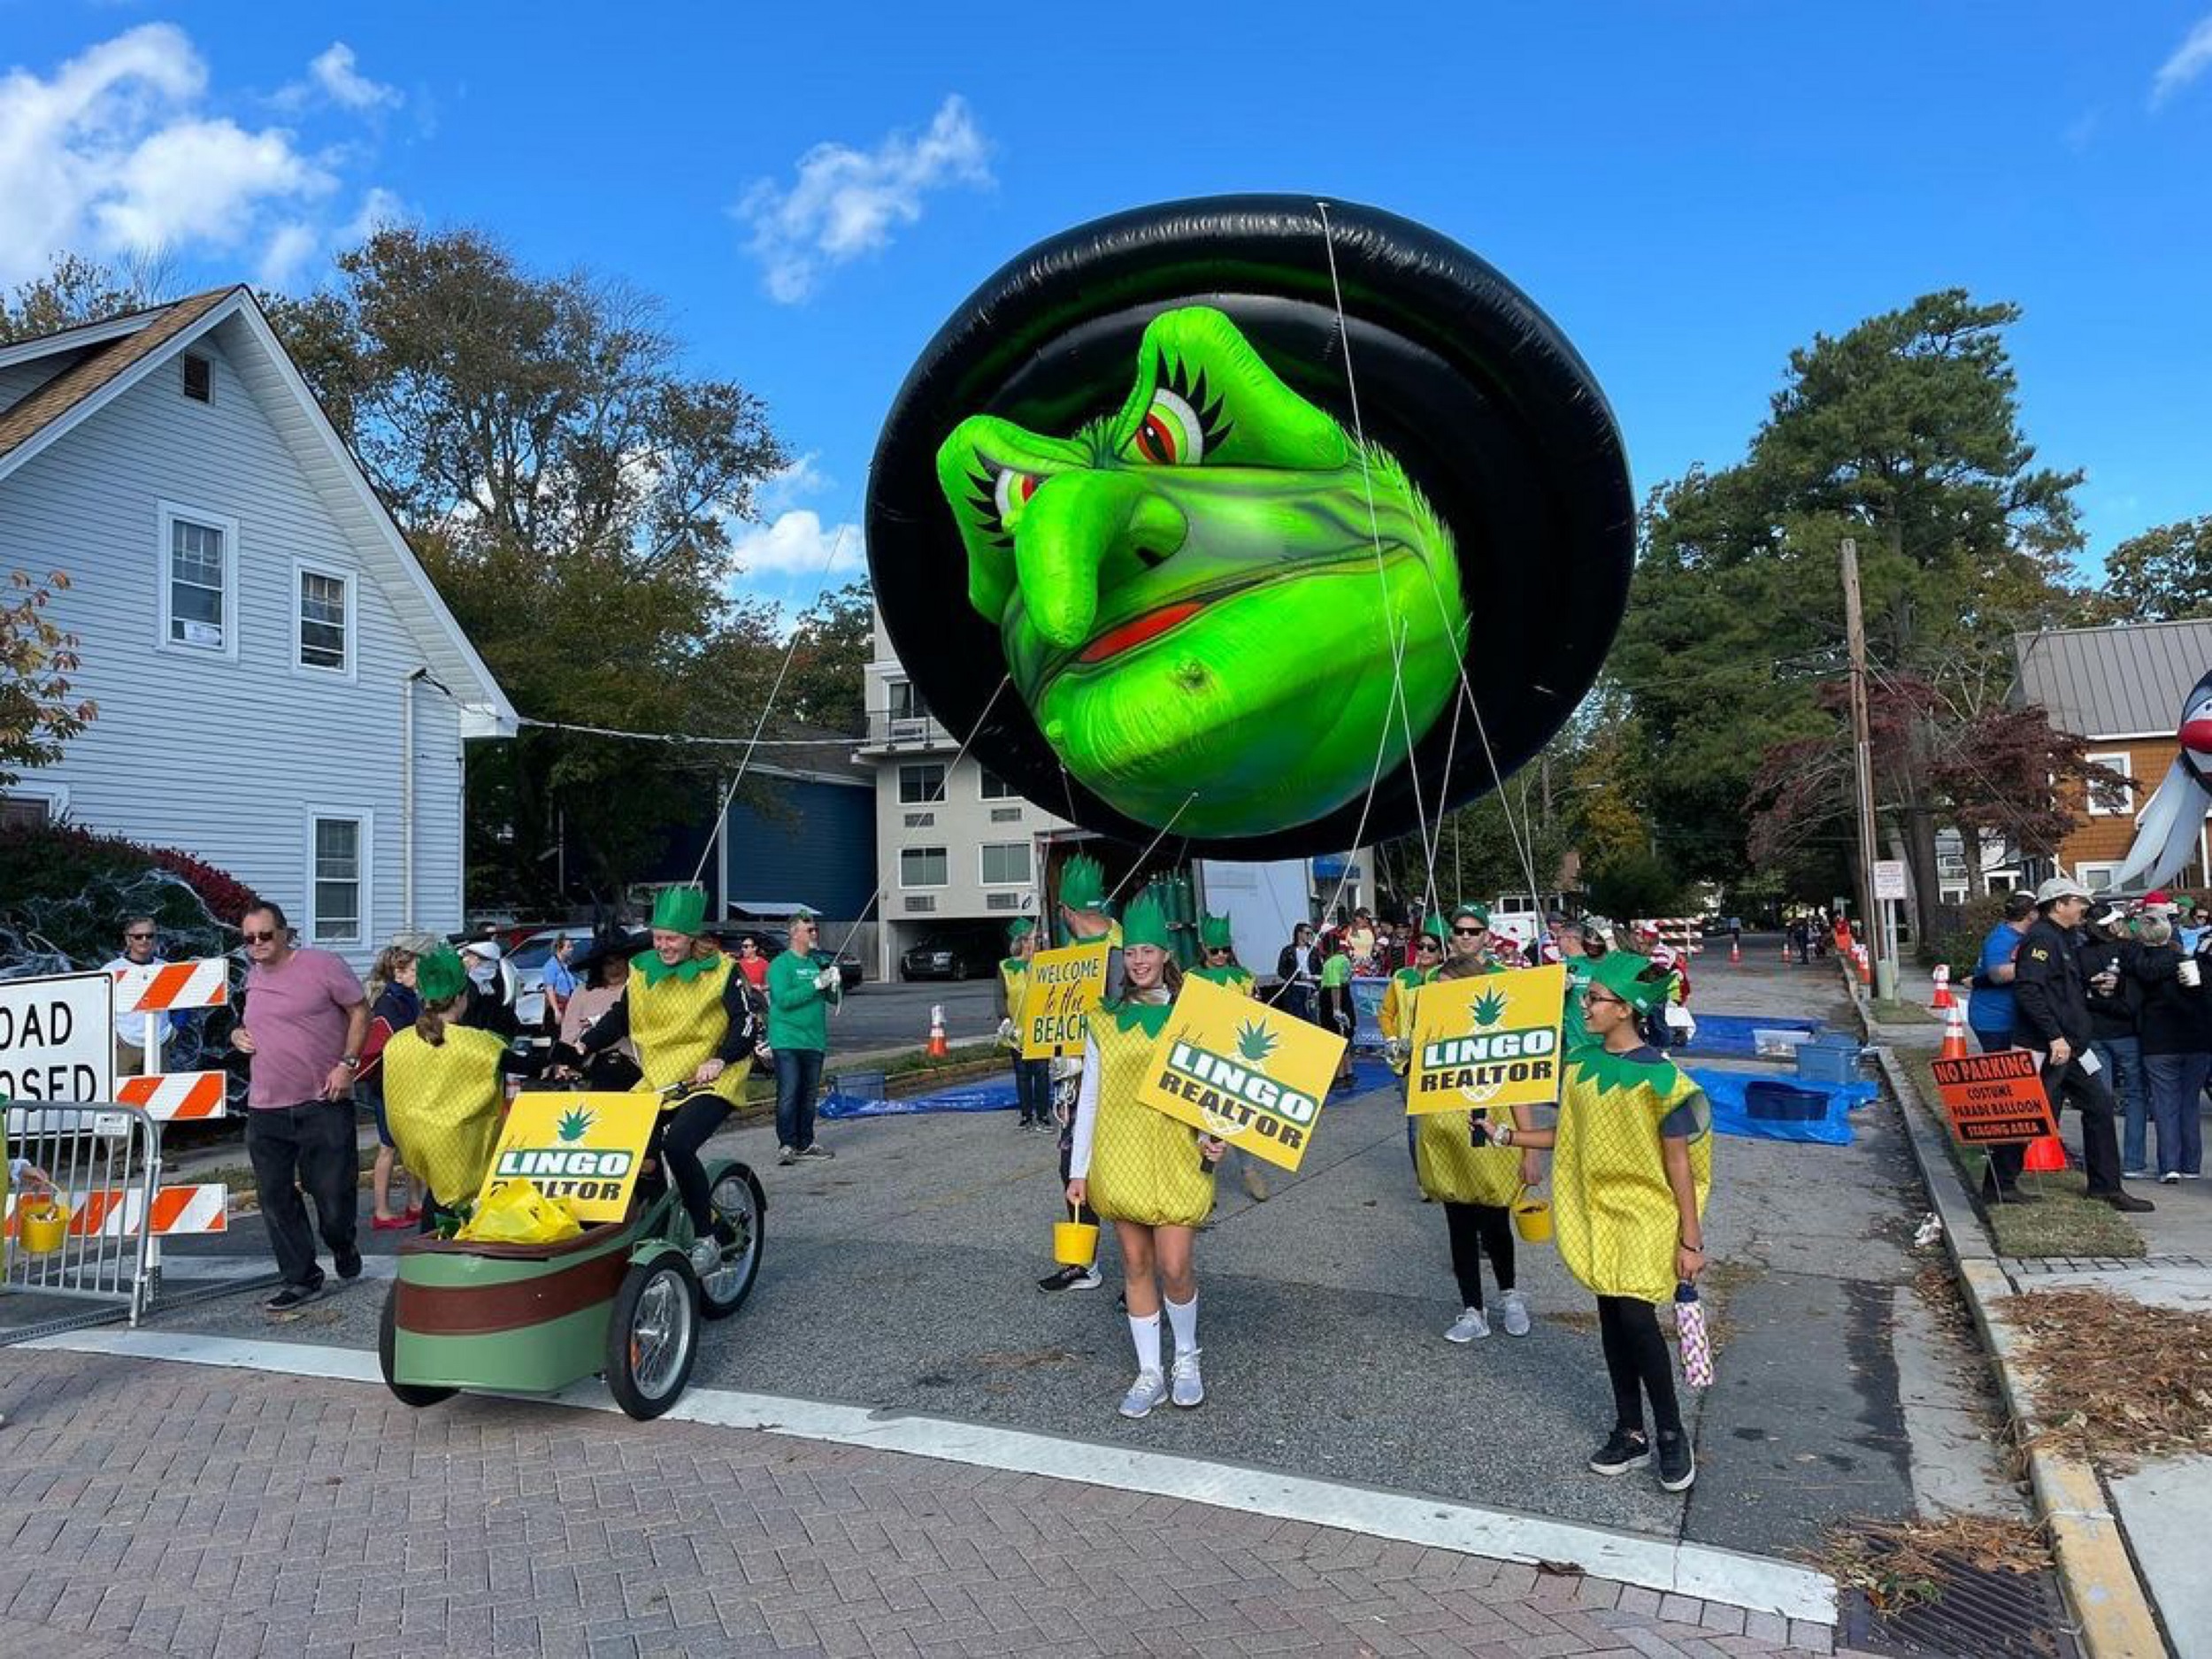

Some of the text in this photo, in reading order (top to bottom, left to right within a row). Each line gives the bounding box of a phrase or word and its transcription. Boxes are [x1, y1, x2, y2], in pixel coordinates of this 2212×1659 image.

[1036, 957, 1099, 984] WELCOME
[1033, 1013, 1088, 1043] BEACH
[1425, 1030, 1554, 1067] LINGO
[1171, 1042, 1315, 1122] LINGO
[1421, 1061, 1552, 1093] REALTOR
[1935, 1053, 2033, 1083] NO PARKING
[1967, 1085, 2014, 1100] COSTUME
[1159, 1071, 1303, 1149] REALTOR
[1992, 1099, 2042, 1115] BALLOON
[1967, 1121, 2039, 1138] STAGING AREA
[497, 1152, 631, 1175] LINGO
[490, 1181, 622, 1200] ALTOR
